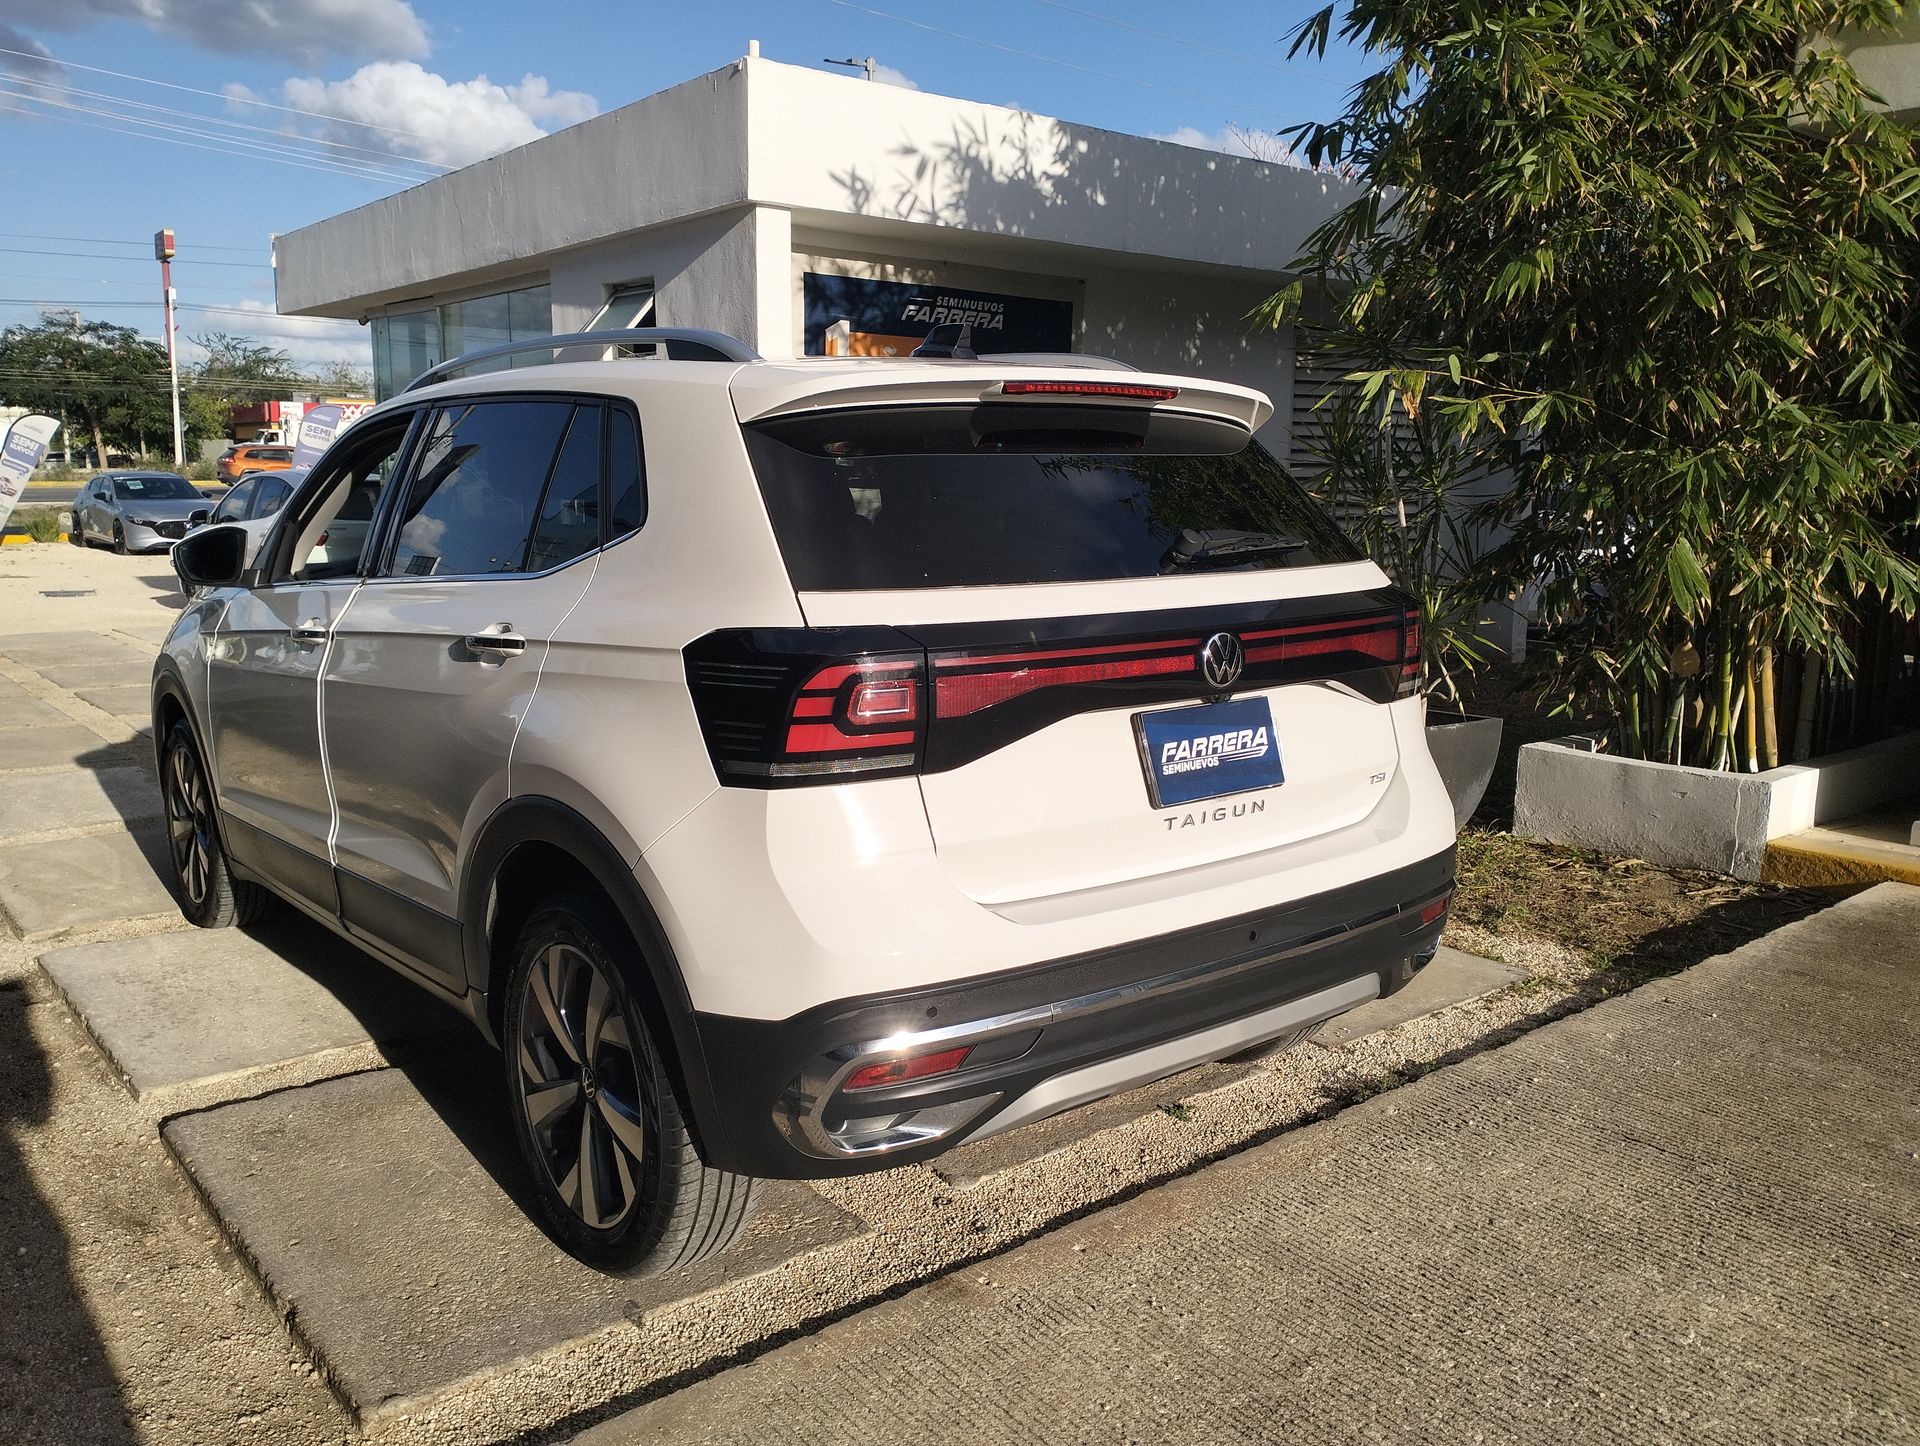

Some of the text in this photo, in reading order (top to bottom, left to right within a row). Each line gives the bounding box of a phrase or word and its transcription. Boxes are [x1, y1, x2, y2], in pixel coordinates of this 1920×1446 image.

[936, 296, 1004, 312] SEMINUEVOS
[901, 304, 1004, 330] FARRERA
[305, 432, 330, 442] NUEVOS
[306, 425, 332, 437] SEMI
[11, 434, 40, 452] SEMI
[1161, 726, 1269, 763] FARRERA
[1162, 756, 1220, 776] SEMINUEVOS
[1369, 772, 1386, 785] TSI
[1163, 799, 1266, 831] TAIGUN
